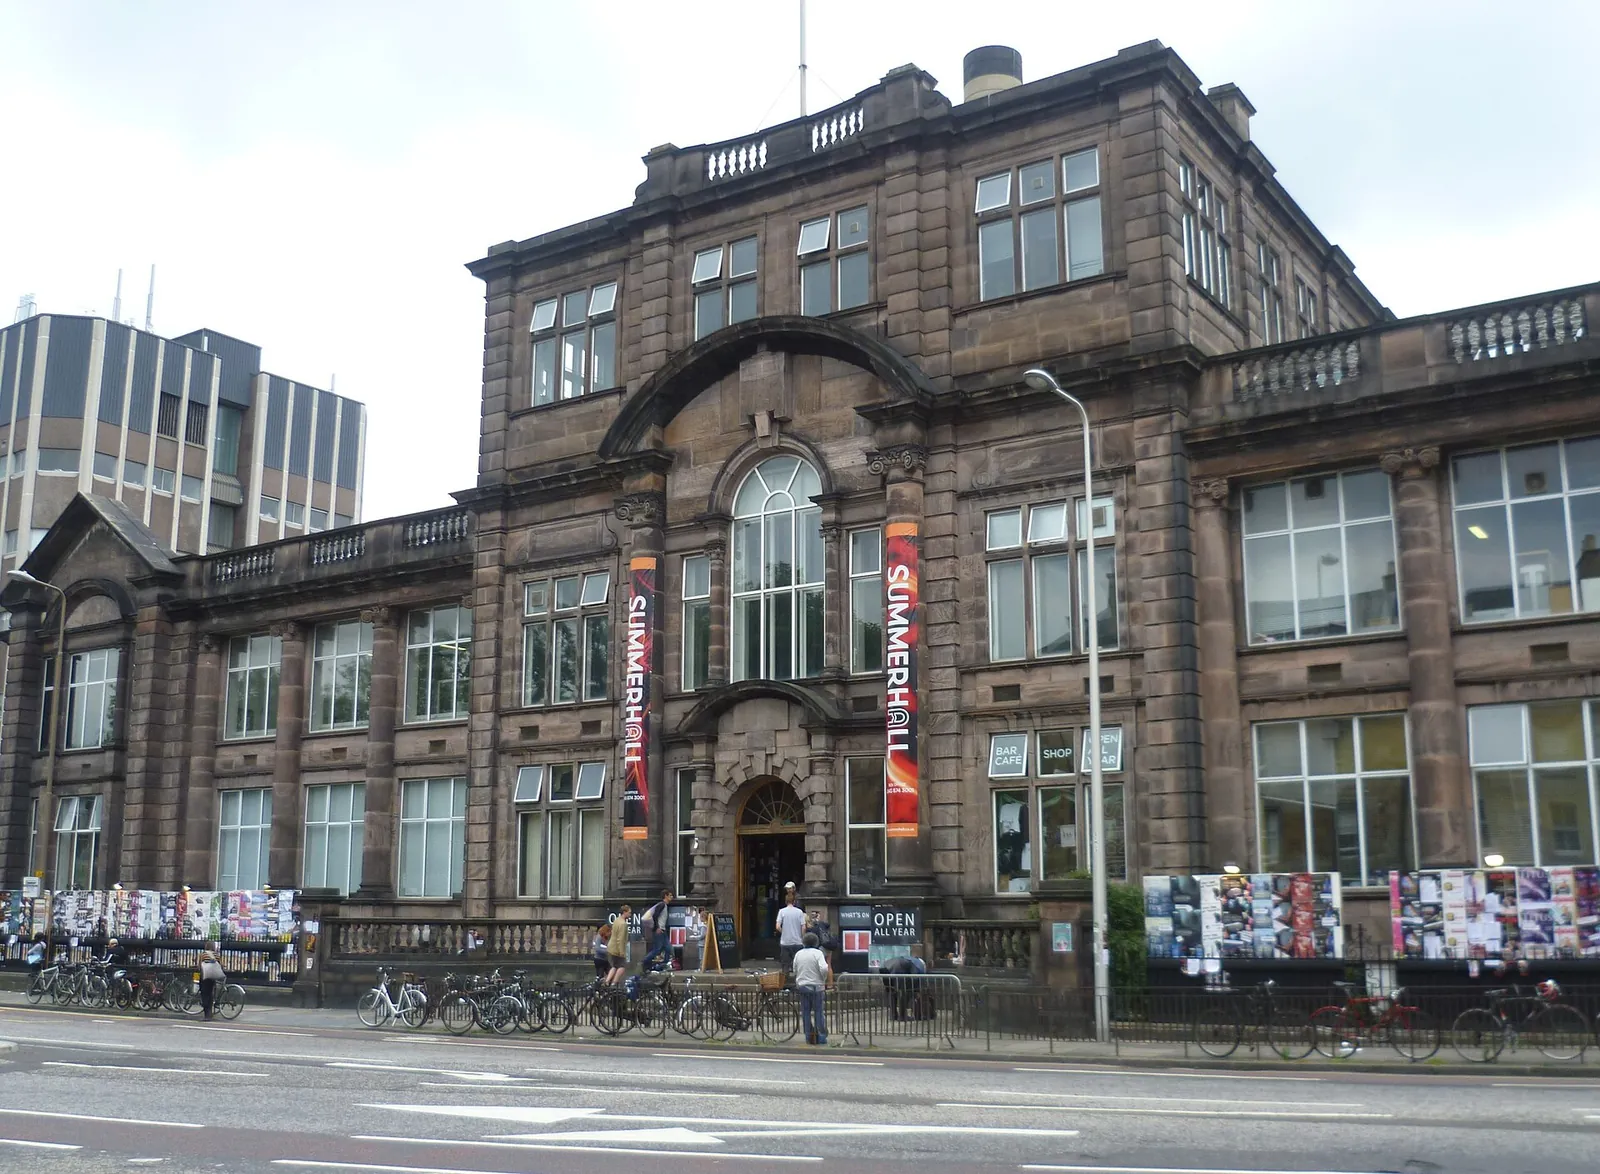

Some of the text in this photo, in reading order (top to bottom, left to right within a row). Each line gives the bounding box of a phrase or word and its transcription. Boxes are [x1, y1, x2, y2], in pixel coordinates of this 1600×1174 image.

[887, 565, 910, 759] SUMMERHALL
[625, 595, 647, 769] SUMMERHALL
[995, 746, 1017, 756] BAR
[1043, 748, 1072, 759] SHOP
[608, 912, 641, 925] OEN
[874, 912, 915, 926] OPEN
[874, 927, 916, 937] ALL YEAR
